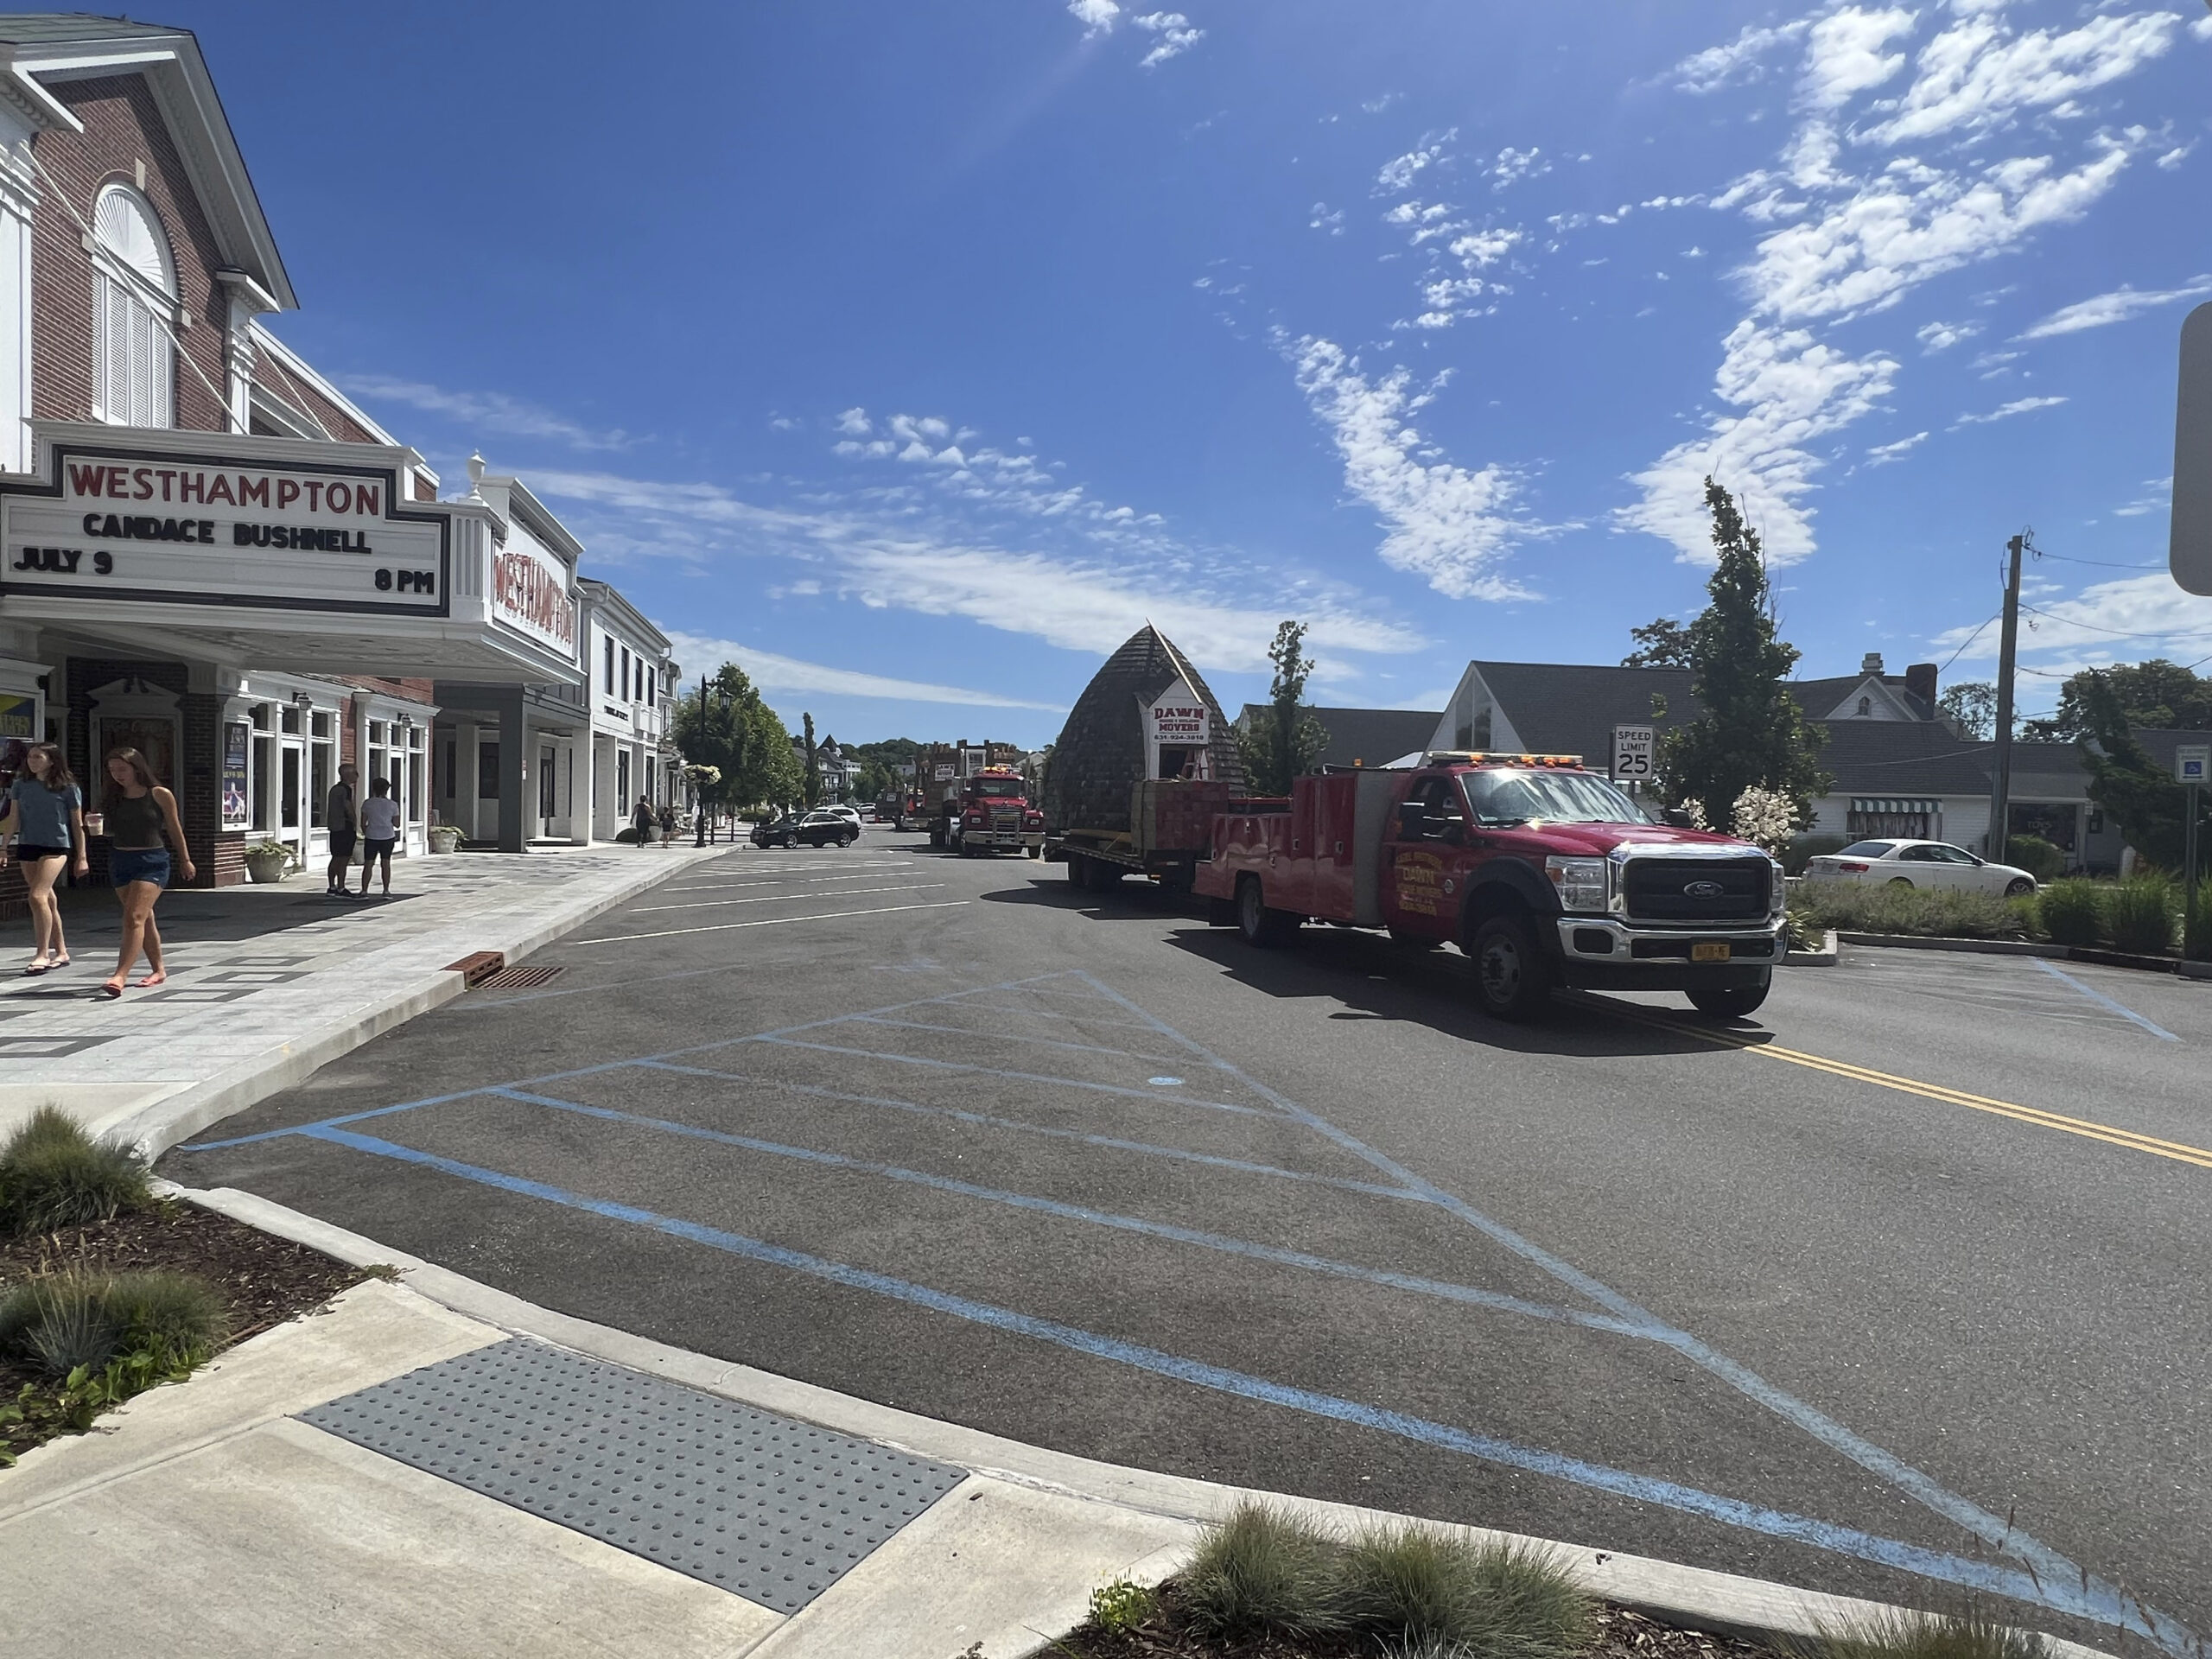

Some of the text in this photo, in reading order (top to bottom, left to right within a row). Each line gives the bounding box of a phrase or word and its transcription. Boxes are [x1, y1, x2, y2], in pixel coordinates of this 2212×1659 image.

[68, 463, 379, 516] WESTHAMPTON
[83, 513, 372, 555] CANDACE BUSHNELL
[14, 547, 113, 575] JULY 9
[374, 568, 435, 594] 8 PM
[1154, 708, 1204, 719] DAWN
[1618, 731, 1651, 741] SPEED
[1621, 743, 1647, 752] LIMIT
[1618, 753, 1649, 774] 25
[1403, 868, 1435, 885] DAWN
